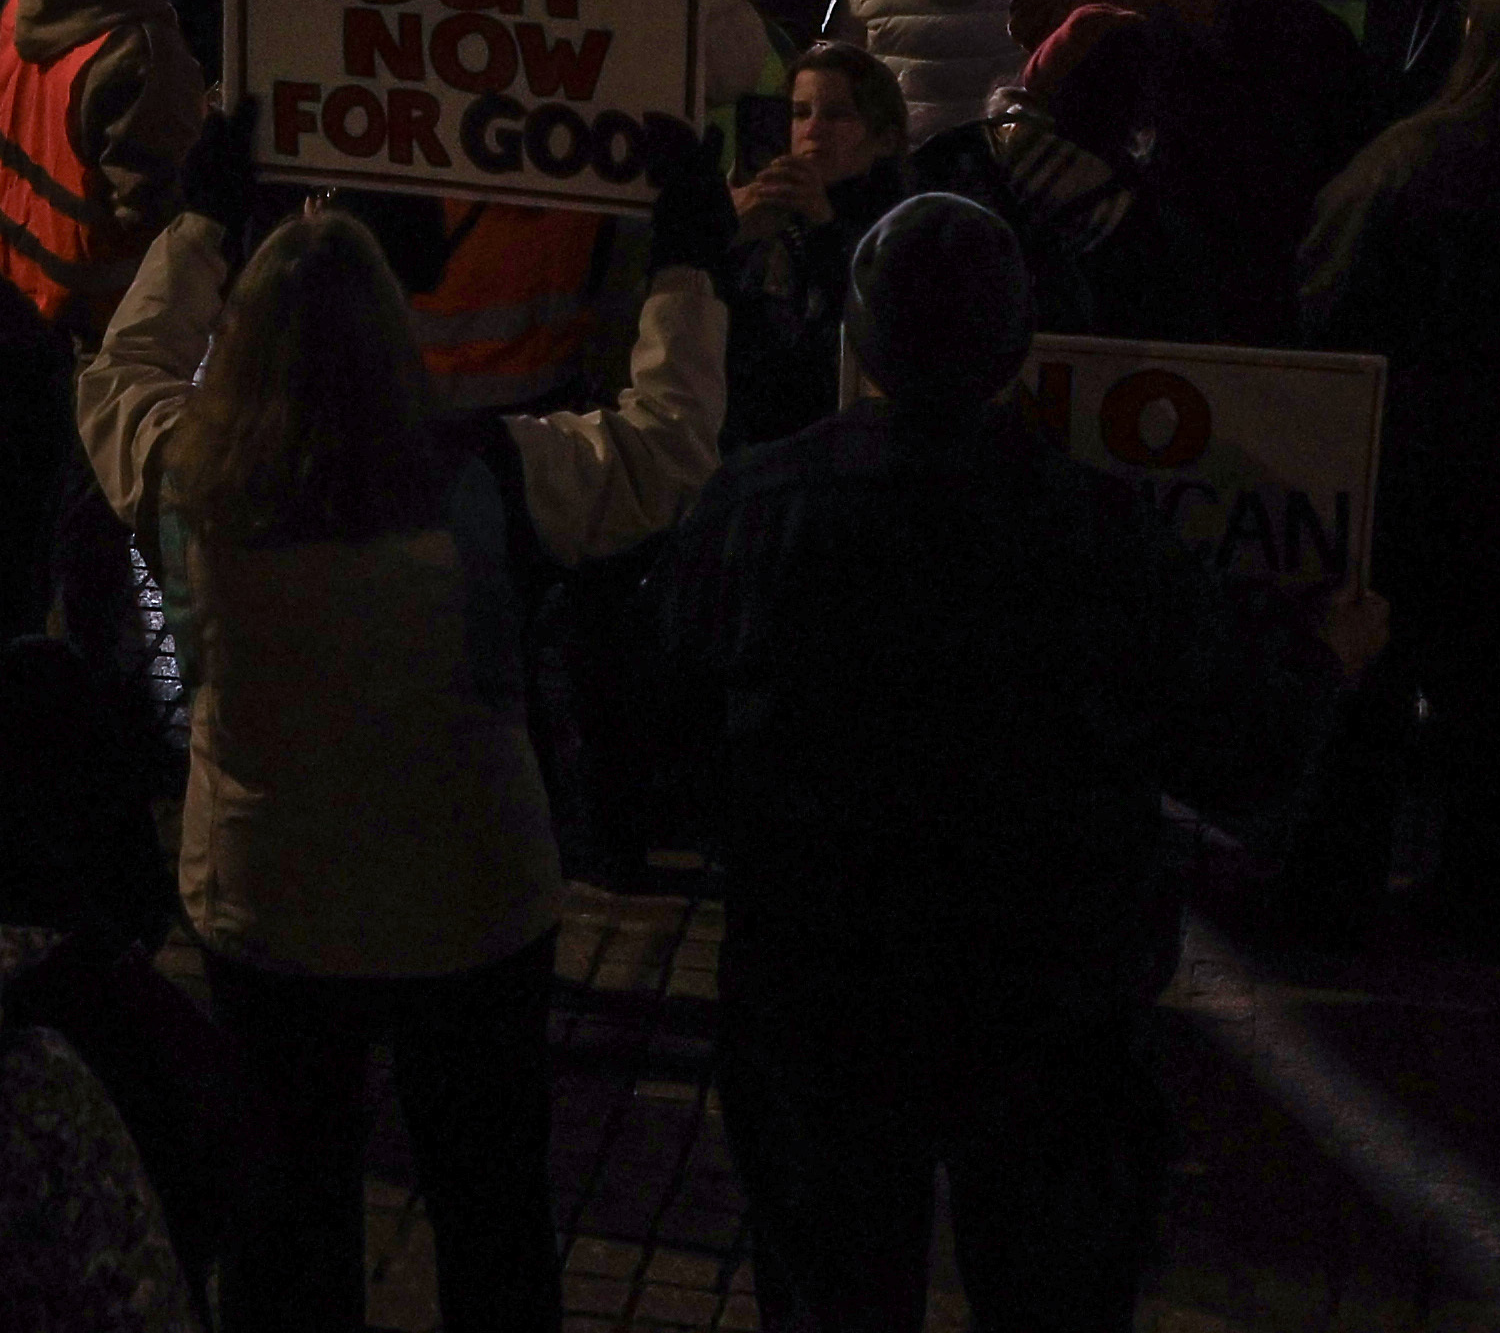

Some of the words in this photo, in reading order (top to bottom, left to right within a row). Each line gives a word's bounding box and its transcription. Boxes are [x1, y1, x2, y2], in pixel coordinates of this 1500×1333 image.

[342, 7, 614, 101] NOW
[272, 80, 453, 168] FOR
[1145, 479, 1349, 575] CAN
